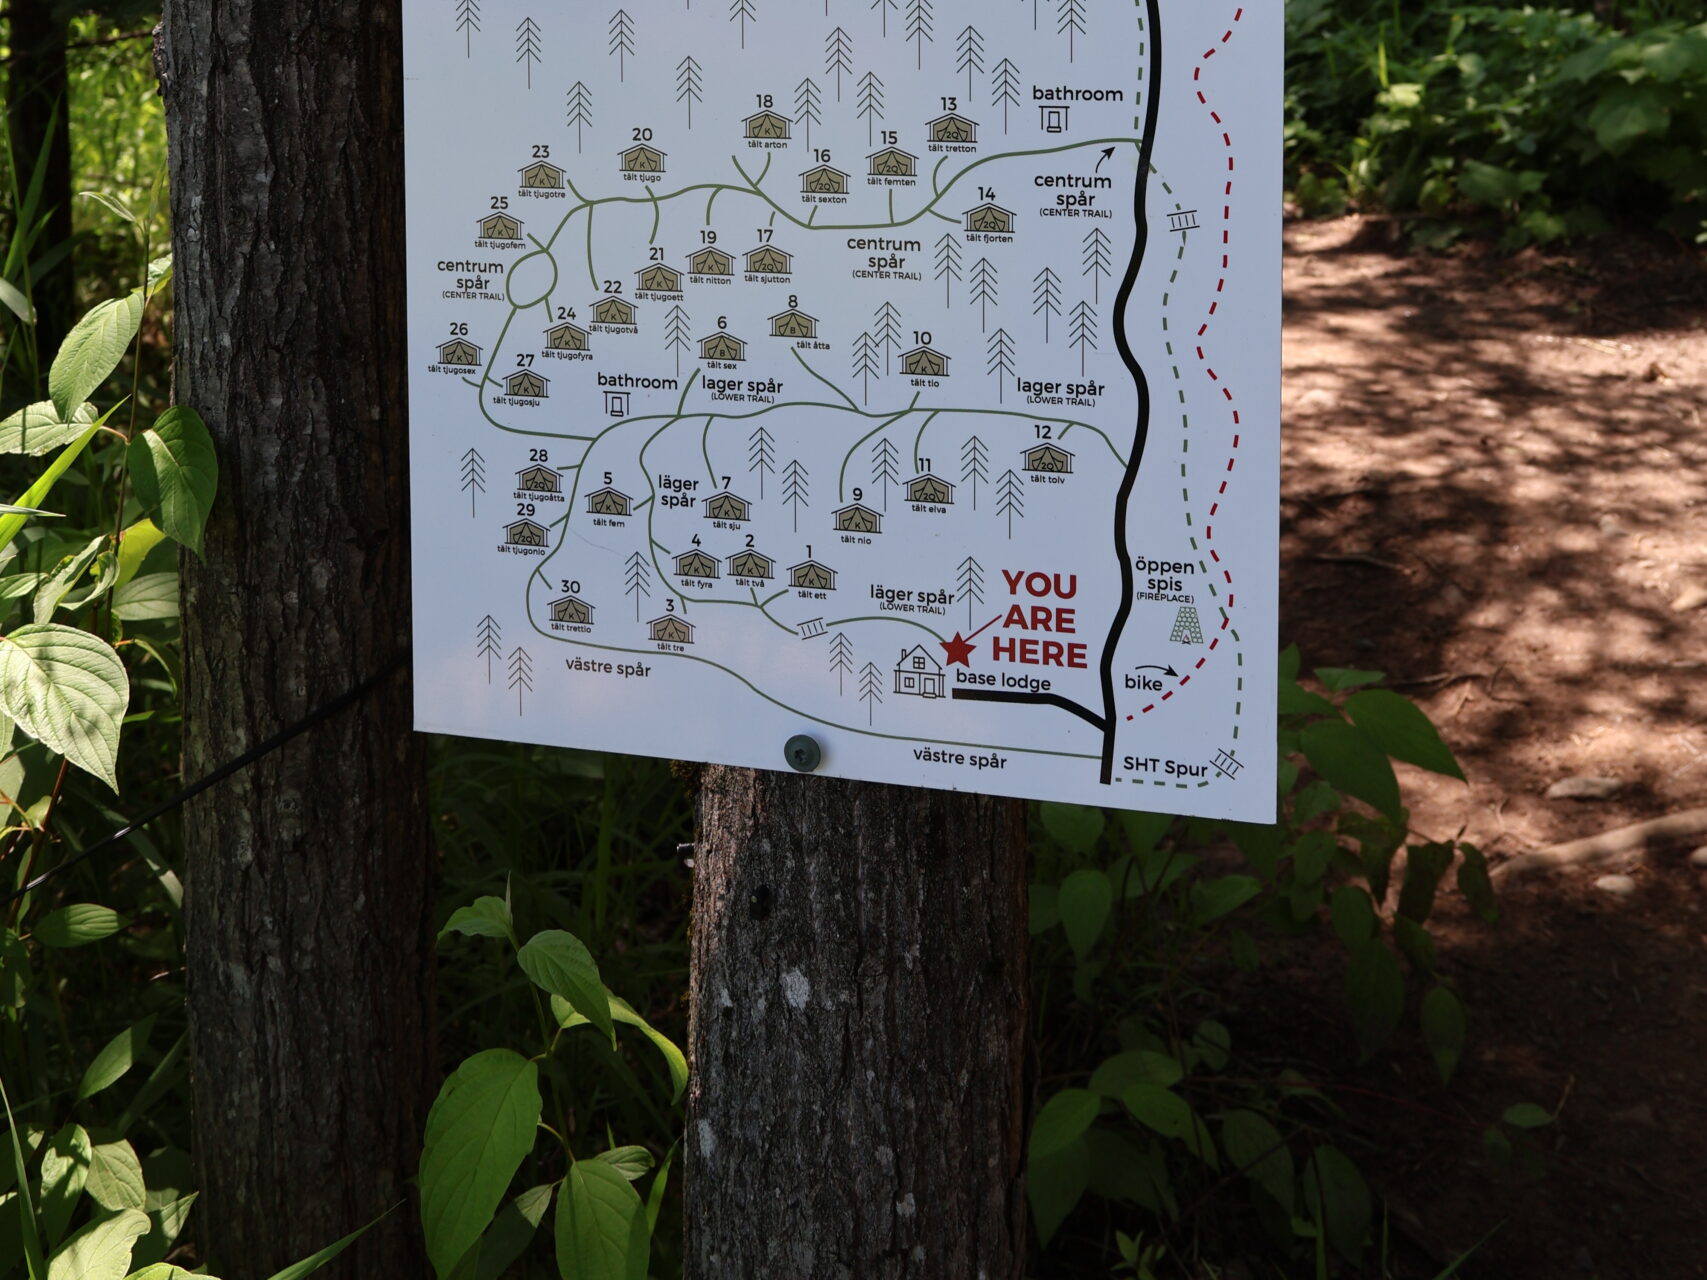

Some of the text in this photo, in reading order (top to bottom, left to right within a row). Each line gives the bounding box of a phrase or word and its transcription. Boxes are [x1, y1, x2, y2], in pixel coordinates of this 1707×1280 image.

[1033, 85, 1123, 102] bathroom
[757, 95, 773, 108] 18
[941, 97, 957, 110] 13
[632, 128, 652, 141] 20
[882, 131, 897, 144] 15
[532, 145, 550, 158] 23
[946, 145, 976, 153] tretton
[814, 150, 830, 162] 16
[639, 174, 661, 182] tjugo
[884, 178, 916, 186] femten
[1034, 174, 1112, 188] centrum
[533, 190, 565, 199] tjugotre
[819, 196, 846, 204] sexton
[978, 187, 995, 201] 14
[1056, 190, 1095, 209] spår
[490, 196, 508, 209] 25
[1040, 208, 1112, 219] (CENTER TRAIL)
[700, 230, 716, 243] 19
[757, 229, 773, 242] 17
[983, 235, 1013, 243] fjorten
[490, 240, 526, 250] tjugofem
[848, 237, 921, 252] centrum
[649, 248, 664, 260] 21
[438, 259, 504, 273] centrum
[869, 253, 905, 272] spår
[456, 274, 490, 290] spår
[761, 276, 790, 284] sjutton
[852, 270, 921, 281] (CENTER TRAIL)
[604, 280, 622, 293] 22
[442, 291, 504, 301] (CENTER TRAIL)
[651, 292, 684, 302] tjugoett
[788, 295, 798, 308] 8
[558, 307, 576, 320] 24
[450, 323, 468, 335] 26
[605, 324, 638, 334] tjugotvå
[718, 316, 727, 329] 6
[913, 331, 931, 345] 10
[813, 341, 830, 350] åtta
[517, 354, 534, 367] 27
[443, 366, 476, 375] tjugosex
[598, 372, 678, 389] bathroom
[702, 375, 783, 395] lager spår
[1017, 378, 1105, 397] lager spår
[711, 393, 774, 404] (LOWER TRAIL)
[1027, 395, 1095, 407] (LOWER TRAIL)
[1035, 425, 1051, 438] 12
[529, 449, 548, 462] 28
[919, 458, 931, 472] 11
[604, 472, 612, 484] 5
[659, 475, 698, 491] läger
[722, 476, 731, 489] 7
[1048, 476, 1064, 484] tolv
[661, 492, 696, 509] spår
[853, 488, 862, 500] 9
[517, 504, 535, 516] 29
[609, 519, 624, 527] fem
[729, 522, 740, 530] sju
[692, 534, 701, 546] 4
[745, 534, 754, 547] 2
[806, 545, 811, 558] 1
[1135, 557, 1194, 576] öppen
[561, 580, 580, 593] 30
[697, 580, 712, 589] fyra
[751, 579, 764, 588] två
[1002, 570, 1077, 599] YOU
[1148, 575, 1182, 592] spis
[815, 592, 826, 600] ett
[870, 584, 954, 605] läger spår
[1136, 592, 1194, 604] (FIREPLACE)
[666, 600, 674, 611] 3
[880, 603, 945, 615] (LOWER TRAIL)
[1003, 605, 1076, 634] ARE
[993, 637, 1088, 668] HERE
[566, 659, 651, 677] västre spår
[956, 670, 1051, 692] base lodge
[1125, 674, 1162, 691] bike
[914, 748, 1007, 769] västre spår
[1124, 756, 1208, 778] SHT Spur
